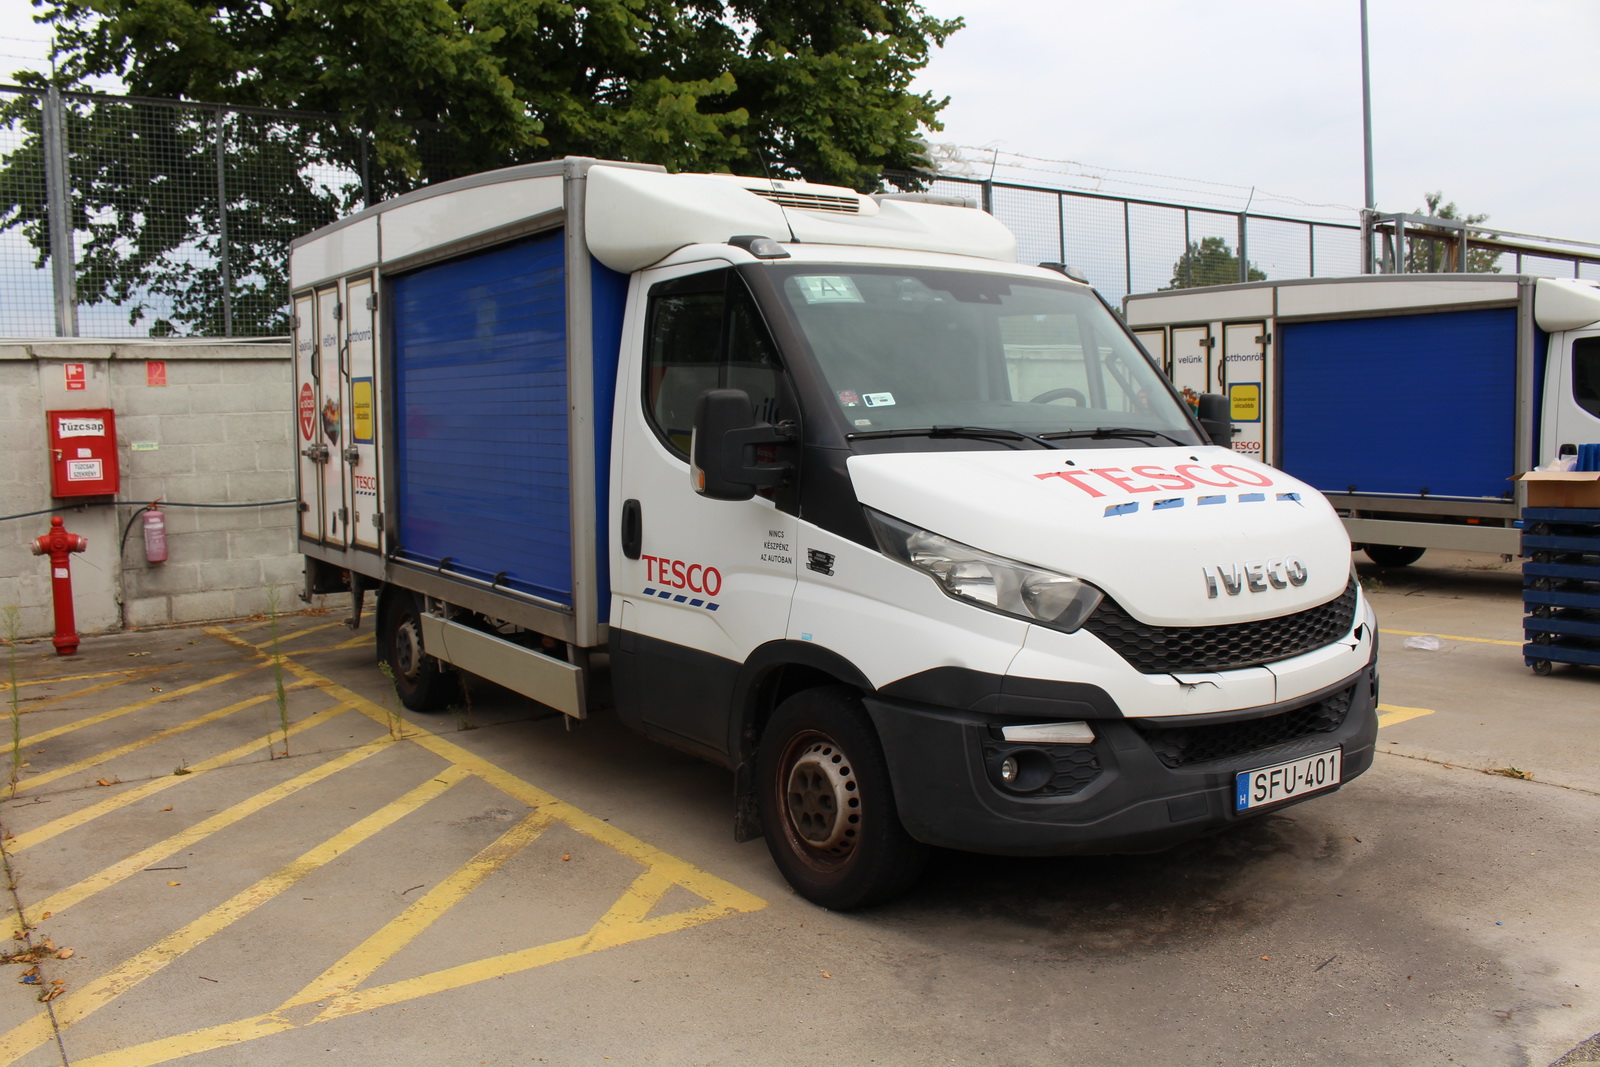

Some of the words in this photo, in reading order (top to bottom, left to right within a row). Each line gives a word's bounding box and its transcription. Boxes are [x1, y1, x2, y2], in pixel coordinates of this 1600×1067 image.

[820, 278, 842, 296] A
[1179, 355, 1202, 364] velünk
[355, 475, 377, 490] TESCO
[1033, 463, 1274, 498] TESCO
[768, 529, 785, 538] NINCS
[763, 540, 789, 552] KÉSZPÉNZ
[760, 553, 767, 561] AZ
[768, 554, 792, 564] AUTÓBAN
[641, 554, 722, 596] TESCO
[1202, 554, 1309, 599] IVECO
[1239, 794, 1246, 805] H
[1253, 755, 1336, 802] SFU-401
